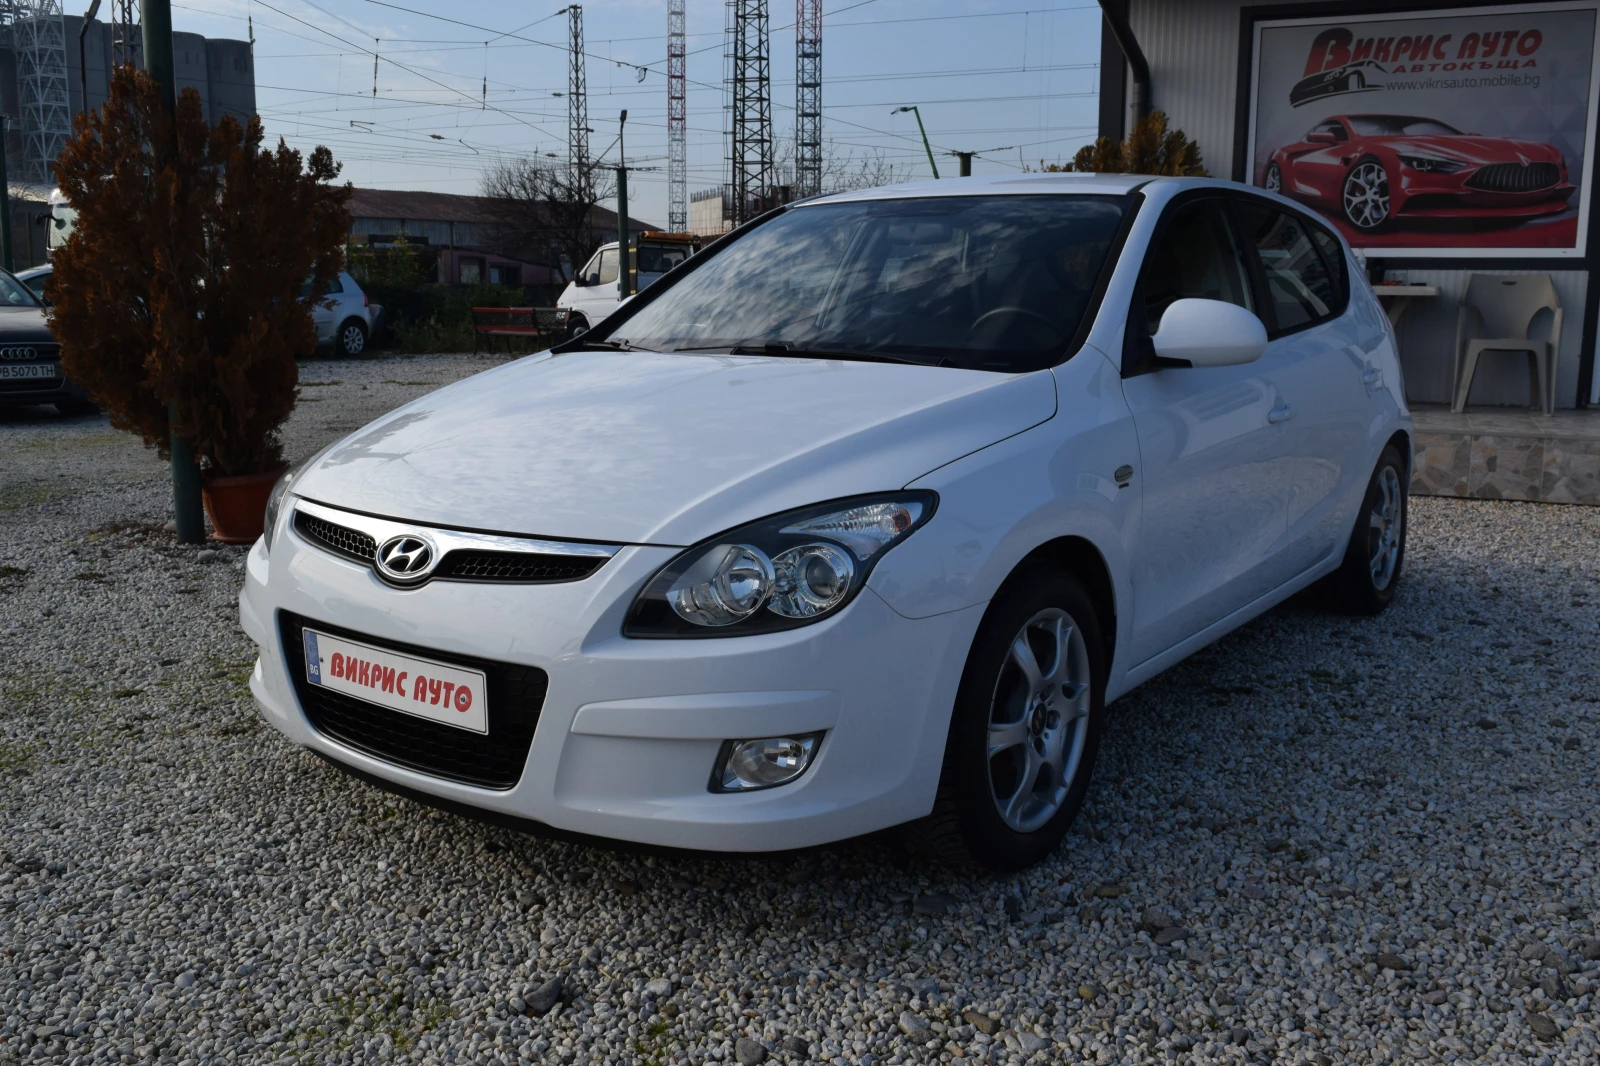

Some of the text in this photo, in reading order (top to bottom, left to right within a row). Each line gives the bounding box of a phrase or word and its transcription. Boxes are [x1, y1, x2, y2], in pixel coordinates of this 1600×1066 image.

[1457, 29, 1543, 57] АУТО
[1391, 59, 1538, 74] АВТОКЪЩА
[1386, 73, 1541, 91] www.vikrisauto.mobile.bg
[11, 366, 38, 377] 5070
[309, 664, 319, 676] BG
[330, 652, 473, 713] ВИКРИС АУТО
